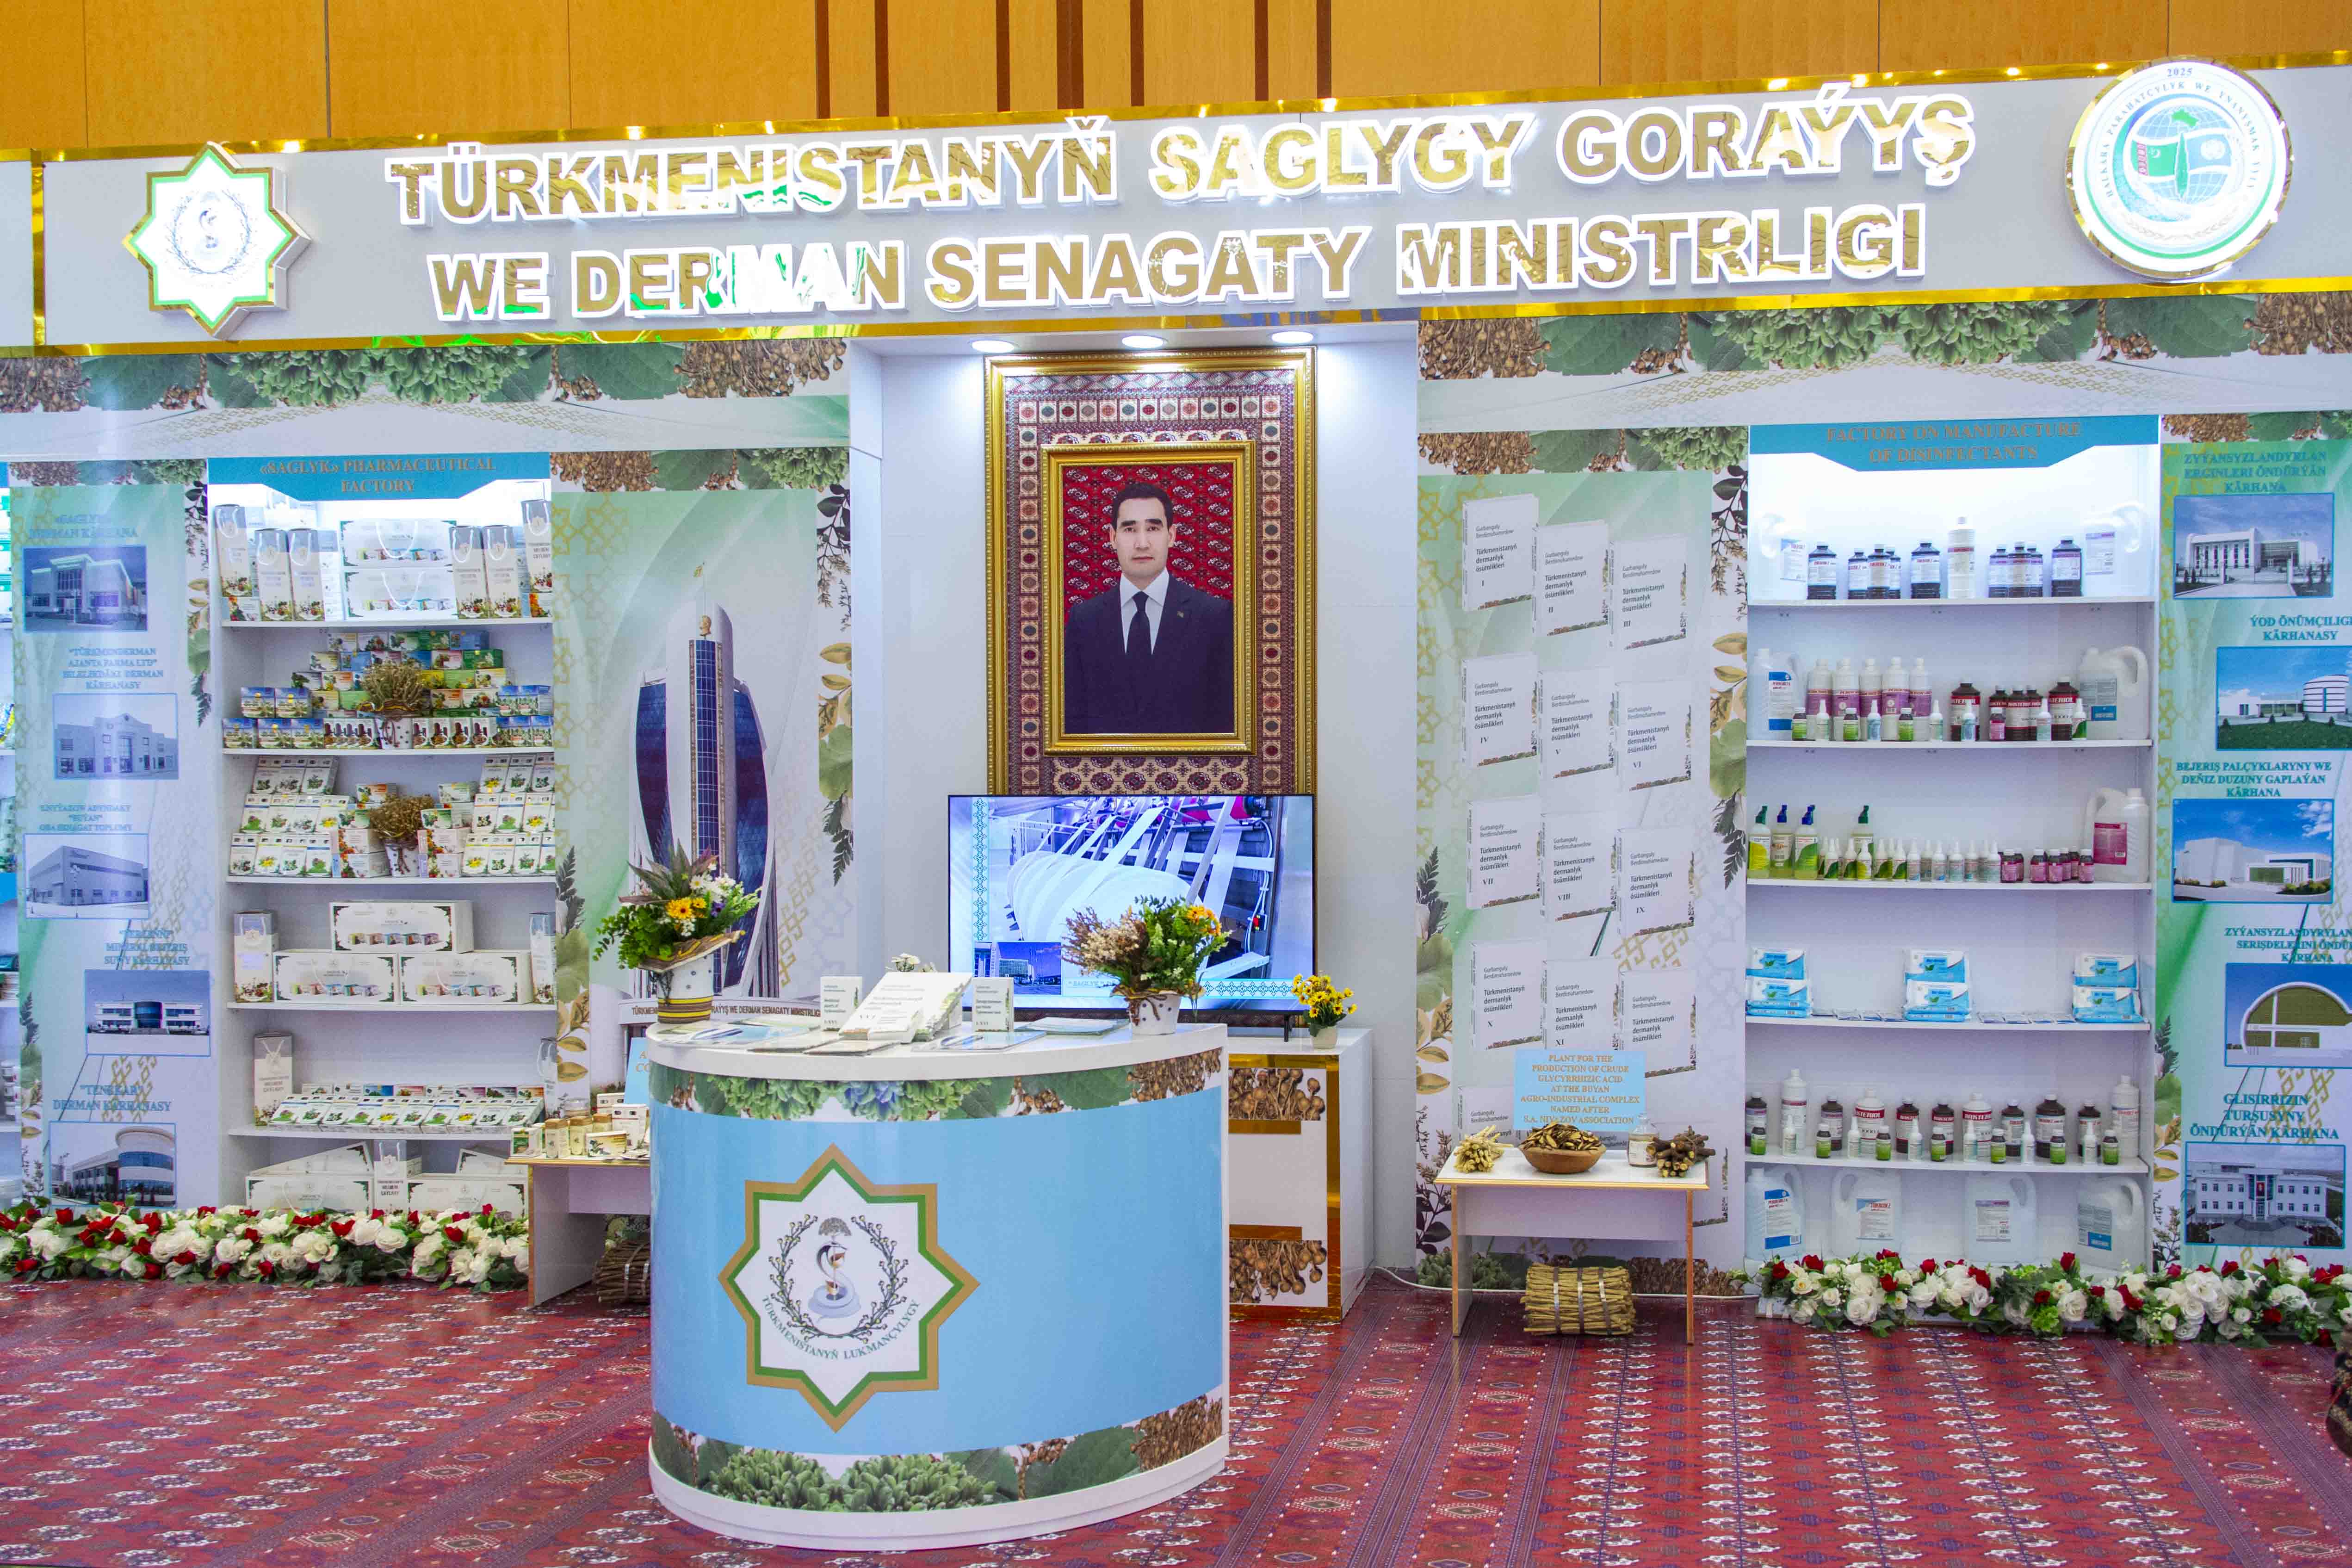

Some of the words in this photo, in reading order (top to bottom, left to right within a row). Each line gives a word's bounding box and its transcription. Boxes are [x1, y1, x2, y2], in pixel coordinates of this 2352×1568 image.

[2167, 68, 2193, 77] 2025
[386, 116, 1117, 225] TÜRKMENISTANYŇ
[1149, 113, 1539, 201] SAGLYGY
[1557, 82, 1975, 186] GORAÝYŞ
[428, 253, 550, 320] WE
[571, 239, 906, 313] DERMAN
[925, 225, 1372, 312] SENAGATY
[1396, 201, 1925, 297] MINISTRLIGI
[1827, 427, 1906, 442] FACTORY
[1914, 426, 1939, 440] ON
[1943, 421, 2081, 439] MANUFACTURE
[1869, 448, 1893, 463] OF
[1898, 445, 2038, 462] DISINFECTANTS
[260, 460, 340, 475] «SAGLYK»
[344, 458, 496, 472] PHARMACEUTICAL
[341, 479, 416, 493] FACTORY
[1476, 554, 1504, 564] dermanlyk
[1476, 563, 1504, 572] ösümlikleri
[1545, 580, 1573, 590] dermanlyk
[1545, 589, 1574, 598] ösümlikleri
[1622, 594, 1651, 603] dermanlyk
[1622, 602, 1652, 612] ösümlikleri
[2250, 615, 2276, 627] ÝOD
[2263, 628, 2339, 641] KÄRHANASY
[1474, 711, 1502, 721] dermanlyk
[1474, 720, 1503, 729] ösümlikleri
[1551, 723, 1579, 733] dermanlyk
[1551, 732, 1580, 741] ösümlikleri
[1627, 735, 1656, 745] dermanlyk
[1627, 744, 1657, 753] ösümlikleri
[2176, 762, 2221, 773] BEJERIŞ
[2222, 762, 2313, 773] PALÇYKLARYNY
[2314, 762, 2332, 771] WE
[2182, 774, 2214, 784] DEŇIZ
[2217, 775, 2264, 784] DUZUNY
[2265, 773, 2326, 784] GAPLAÝAN
[2226, 786, 2281, 797] KÄRHANA
[1480, 853, 1508, 863] dermanlyk
[1480, 862, 1509, 871] ösümlikleri
[1554, 866, 1581, 875] dermanlyk
[1554, 874, 1582, 884] ösümlikleri
[1630, 881, 1659, 891] dermanlyk
[1630, 890, 1659, 899] ösümlikleri
[1484, 995, 1511, 1004] dermanlyk
[791, 1008, 821, 1017] MINISTRLIG
[1484, 1004, 1512, 1013] ösümlikleri
[1555, 1013, 1583, 1023] dermanlyk
[1555, 1022, 1584, 1031] ösümlikleri
[1632, 1024, 1661, 1034] dermanlyk
[1632, 1033, 1662, 1042] ösümlikleri
[1532, 1065, 1586, 1073] PRODUCTION
[1521, 1095, 1597, 1103] AGRO-INDUSTRIAL
[762, 1295, 839, 1360] TÜRKMENISTANYŇ
[843, 1299, 921, 1360] LUKMANÇYLYGY
